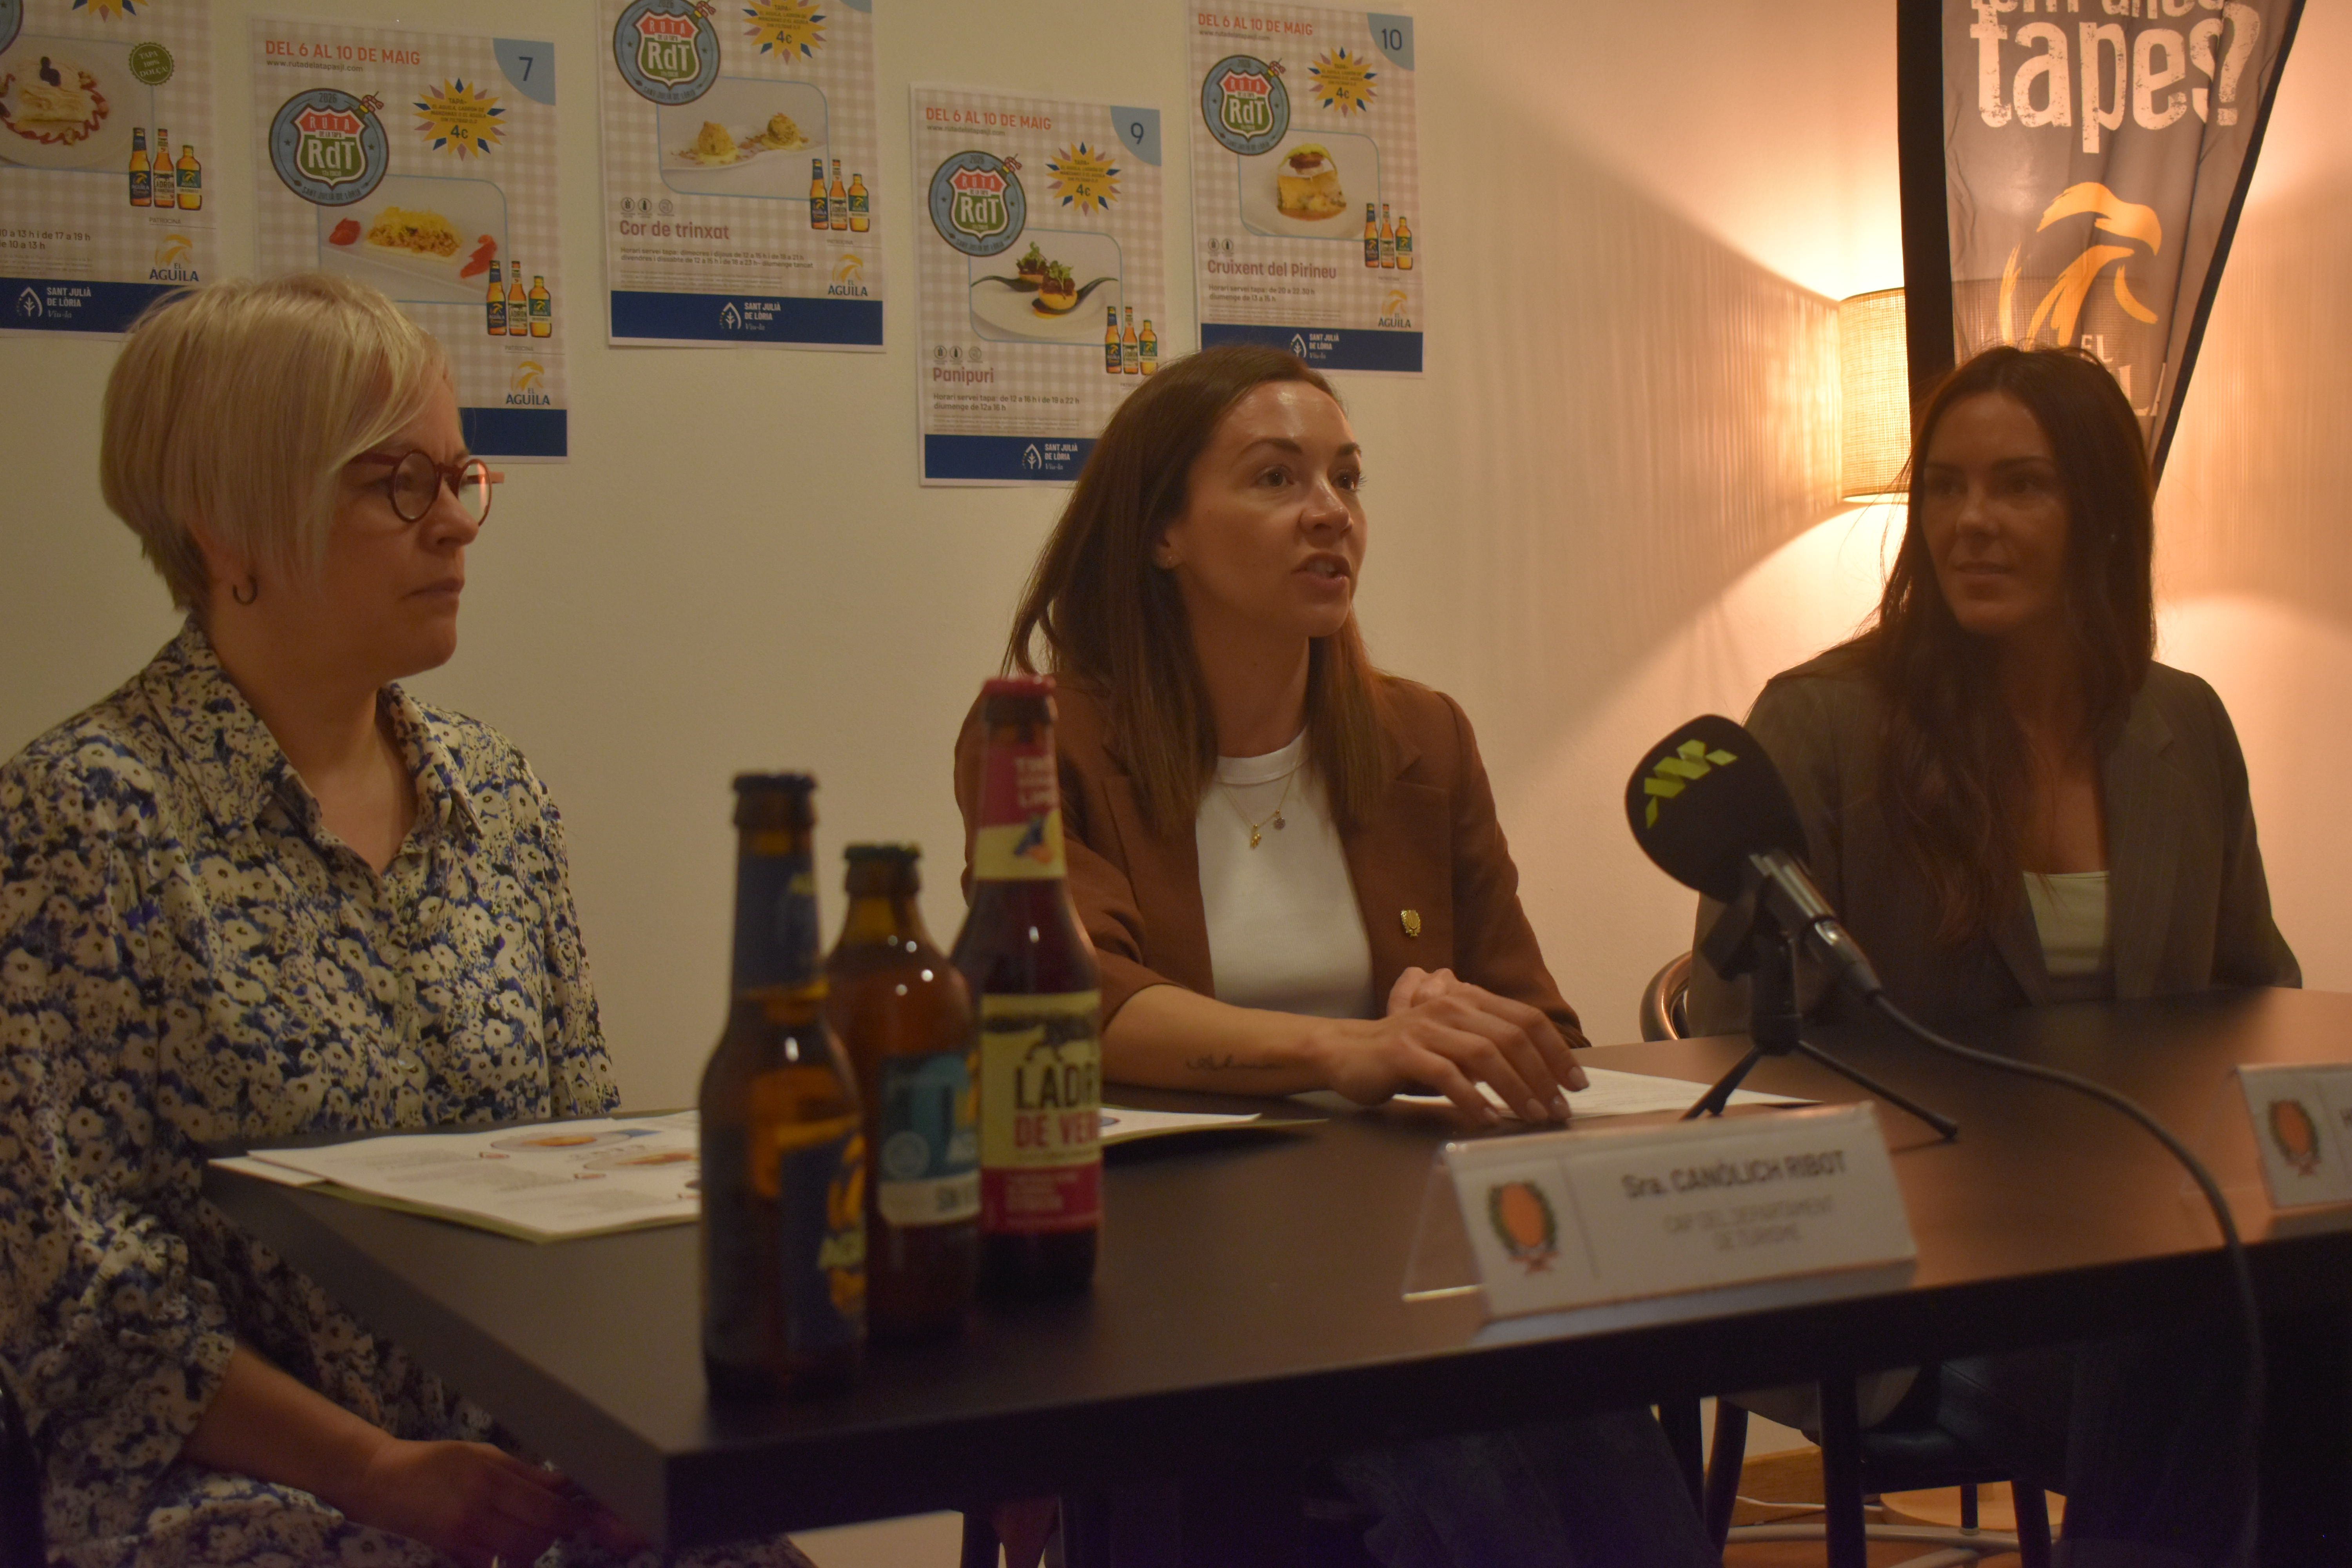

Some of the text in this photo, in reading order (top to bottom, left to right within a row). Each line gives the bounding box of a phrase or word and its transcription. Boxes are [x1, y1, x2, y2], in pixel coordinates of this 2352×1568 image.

[649, 20, 685, 34] RUTA
[1198, 13, 1313, 36] DEL 6 AL 10 DE MAIG
[1382, 29, 1403, 51] 10
[138, 50, 158, 60] TAPA
[265, 40, 421, 65] DEL 6 AL 10 DE MAIG
[648, 42, 690, 71] RdT
[267, 59, 364, 72] www.rutadelatapasjl.com
[519, 56, 534, 81] 7
[1230, 78, 1261, 92] RUTA
[1970, 2, 2260, 153] tapes?
[319, 93, 338, 103] 2026
[926, 107, 1052, 131] DEL 6 AL 10 DE MAIG
[1229, 98, 1264, 125] RdT
[309, 116, 350, 131] RUTA
[1131, 122, 1144, 144] 9
[308, 139, 355, 170] RdT
[962, 175, 995, 189] RUTA
[960, 196, 999, 224] RdT
[42, 231, 53, 240] de
[620, 220, 730, 240] Cor de trinxat
[29, 241, 37, 249] 13
[149, 267, 199, 281] ÁGUILA
[1208, 259, 1337, 279] Cruixent del Pirineu
[47, 287, 91, 297] SANT JULIÀ
[1209, 292, 1241, 302] diumenge
[47, 297, 82, 307] DE LÒRIA
[744, 302, 762, 310] SANT
[933, 367, 994, 386] Panipuri
[934, 403, 969, 412] diumenge
